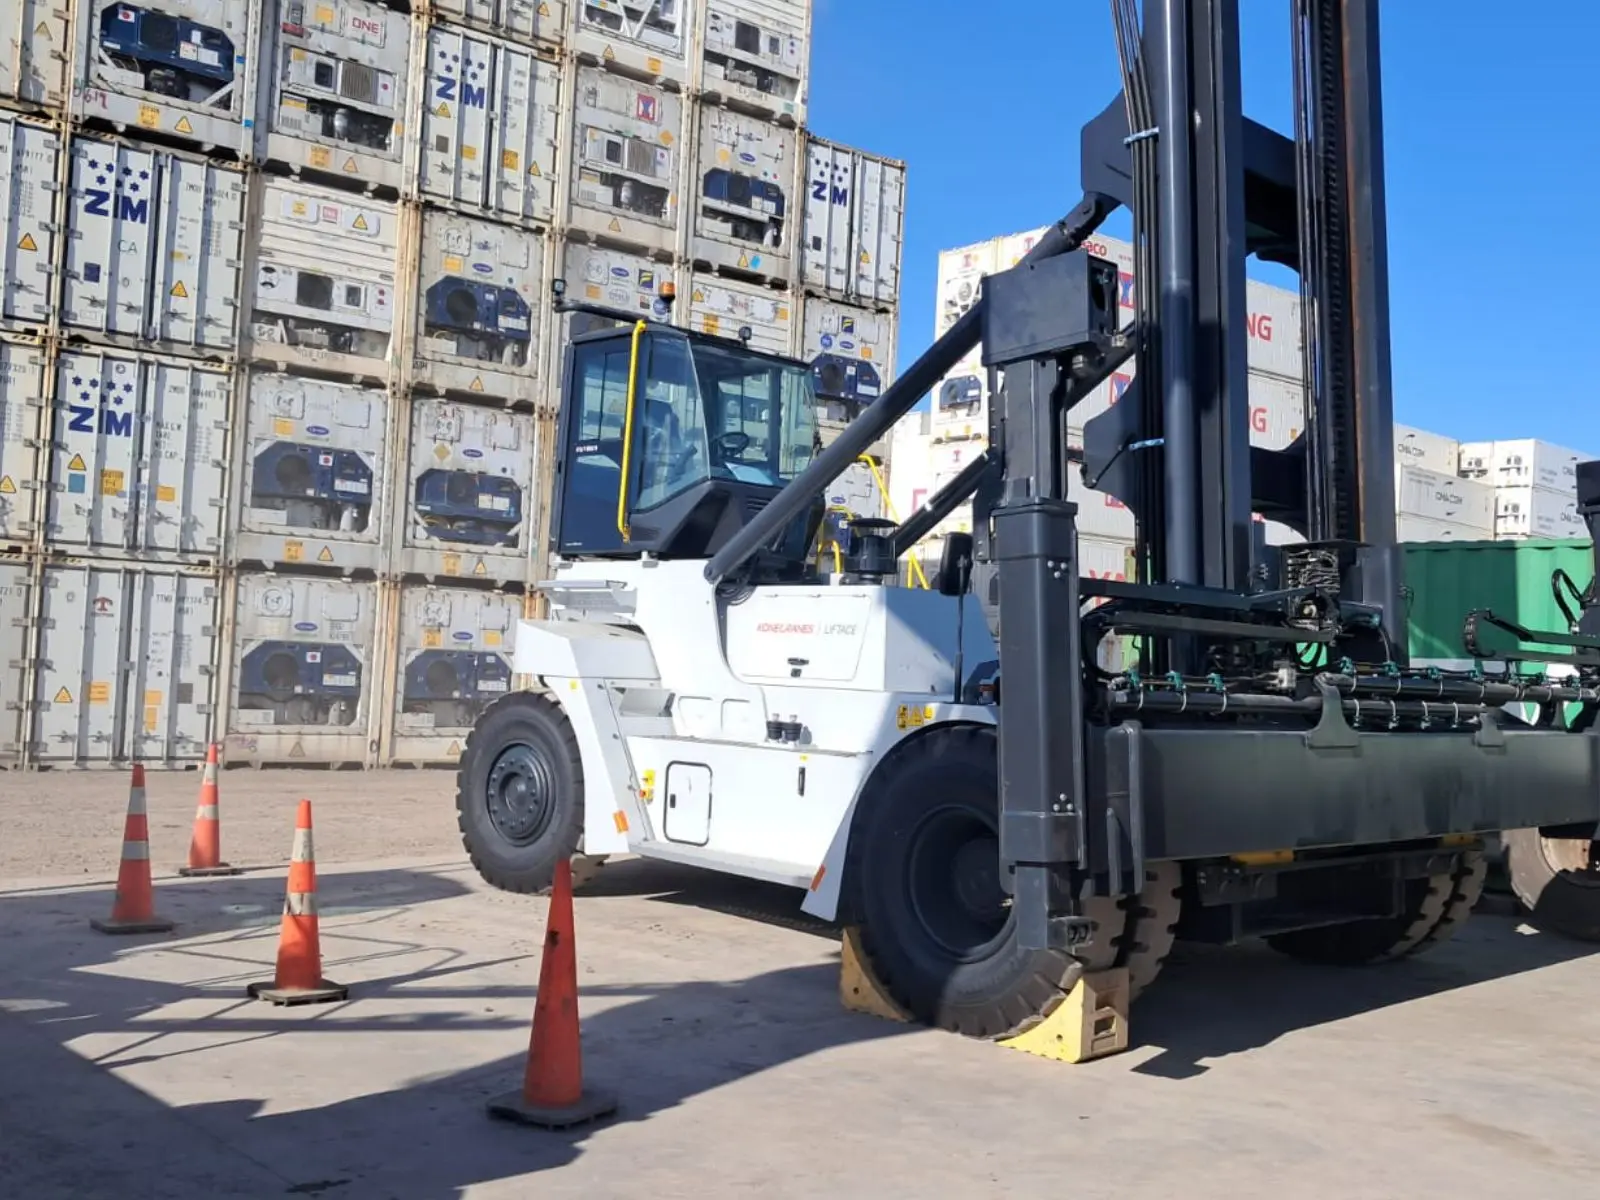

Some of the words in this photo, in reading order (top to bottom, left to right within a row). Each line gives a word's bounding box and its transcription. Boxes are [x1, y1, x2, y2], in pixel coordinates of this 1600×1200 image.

[352, 17, 379, 34] ONE
[436, 75, 485, 109] ZIM
[84, 188, 148, 225] ZIM
[812, 180, 848, 207] ZIM
[1245, 312, 1272, 342] NG
[68, 405, 132, 438] ZIM
